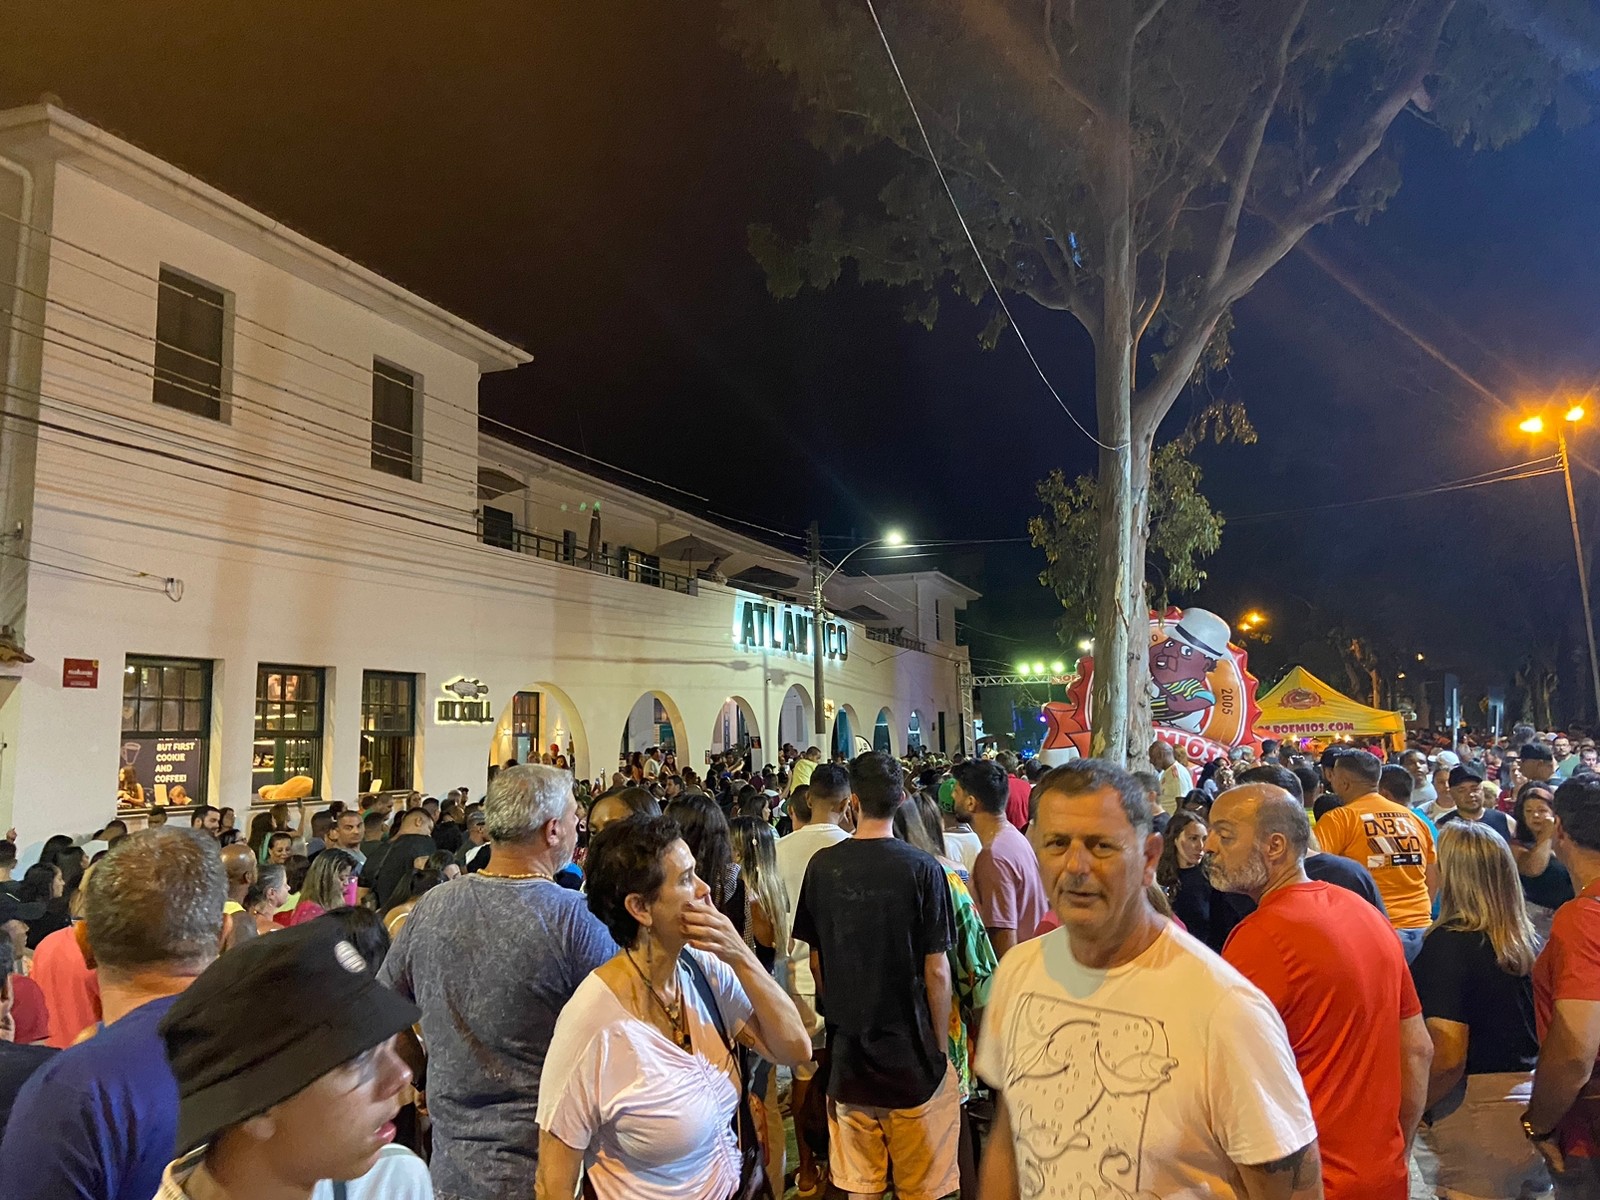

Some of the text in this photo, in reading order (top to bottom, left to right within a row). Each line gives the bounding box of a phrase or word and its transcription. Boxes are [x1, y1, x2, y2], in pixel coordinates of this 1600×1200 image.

[740, 601, 848, 661] ATLÂNICO
[1221, 688, 1233, 716] 2005
[156, 742, 195, 752] BUT FIRST
[156, 753, 186, 762] COOKIE
[155, 764, 172, 772] AND
